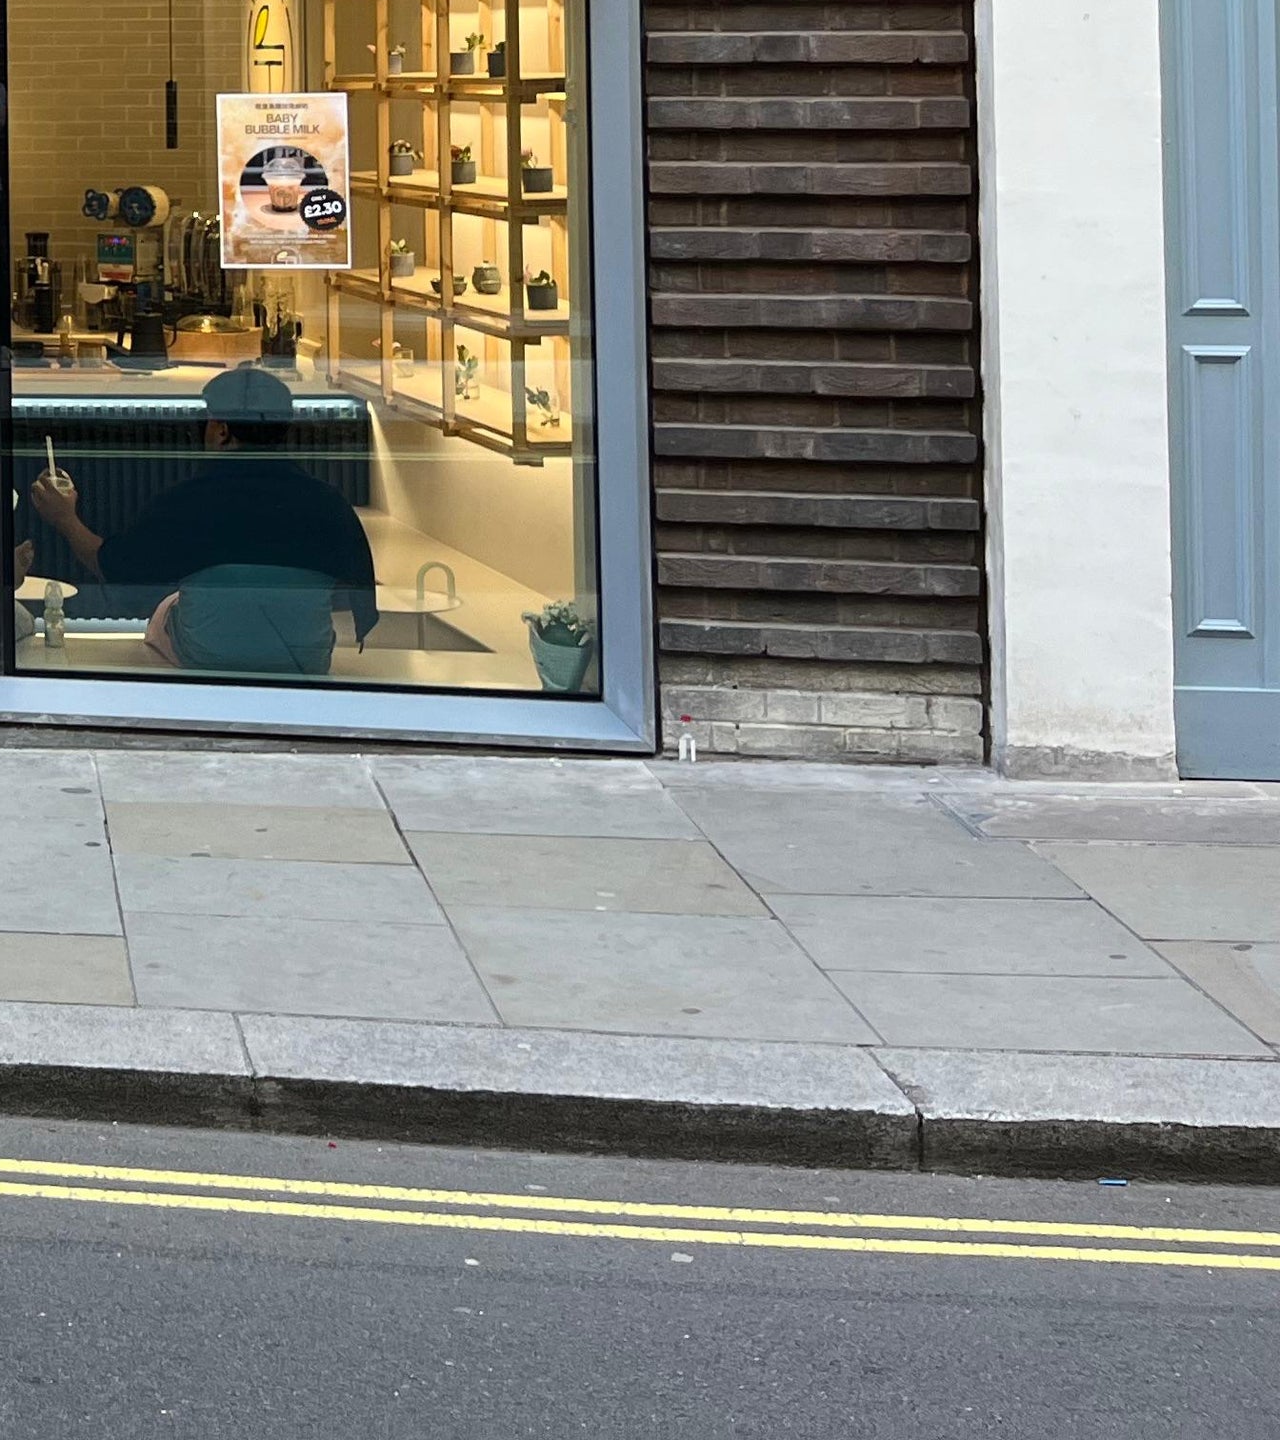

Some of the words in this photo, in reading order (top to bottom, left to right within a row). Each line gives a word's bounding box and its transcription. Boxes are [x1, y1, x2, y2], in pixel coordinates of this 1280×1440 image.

[266, 113, 298, 123] BABY
[245, 125, 291, 135] BUBBLE
[292, 124, 320, 134] MILK
[304, 201, 343, 218] £2.30
